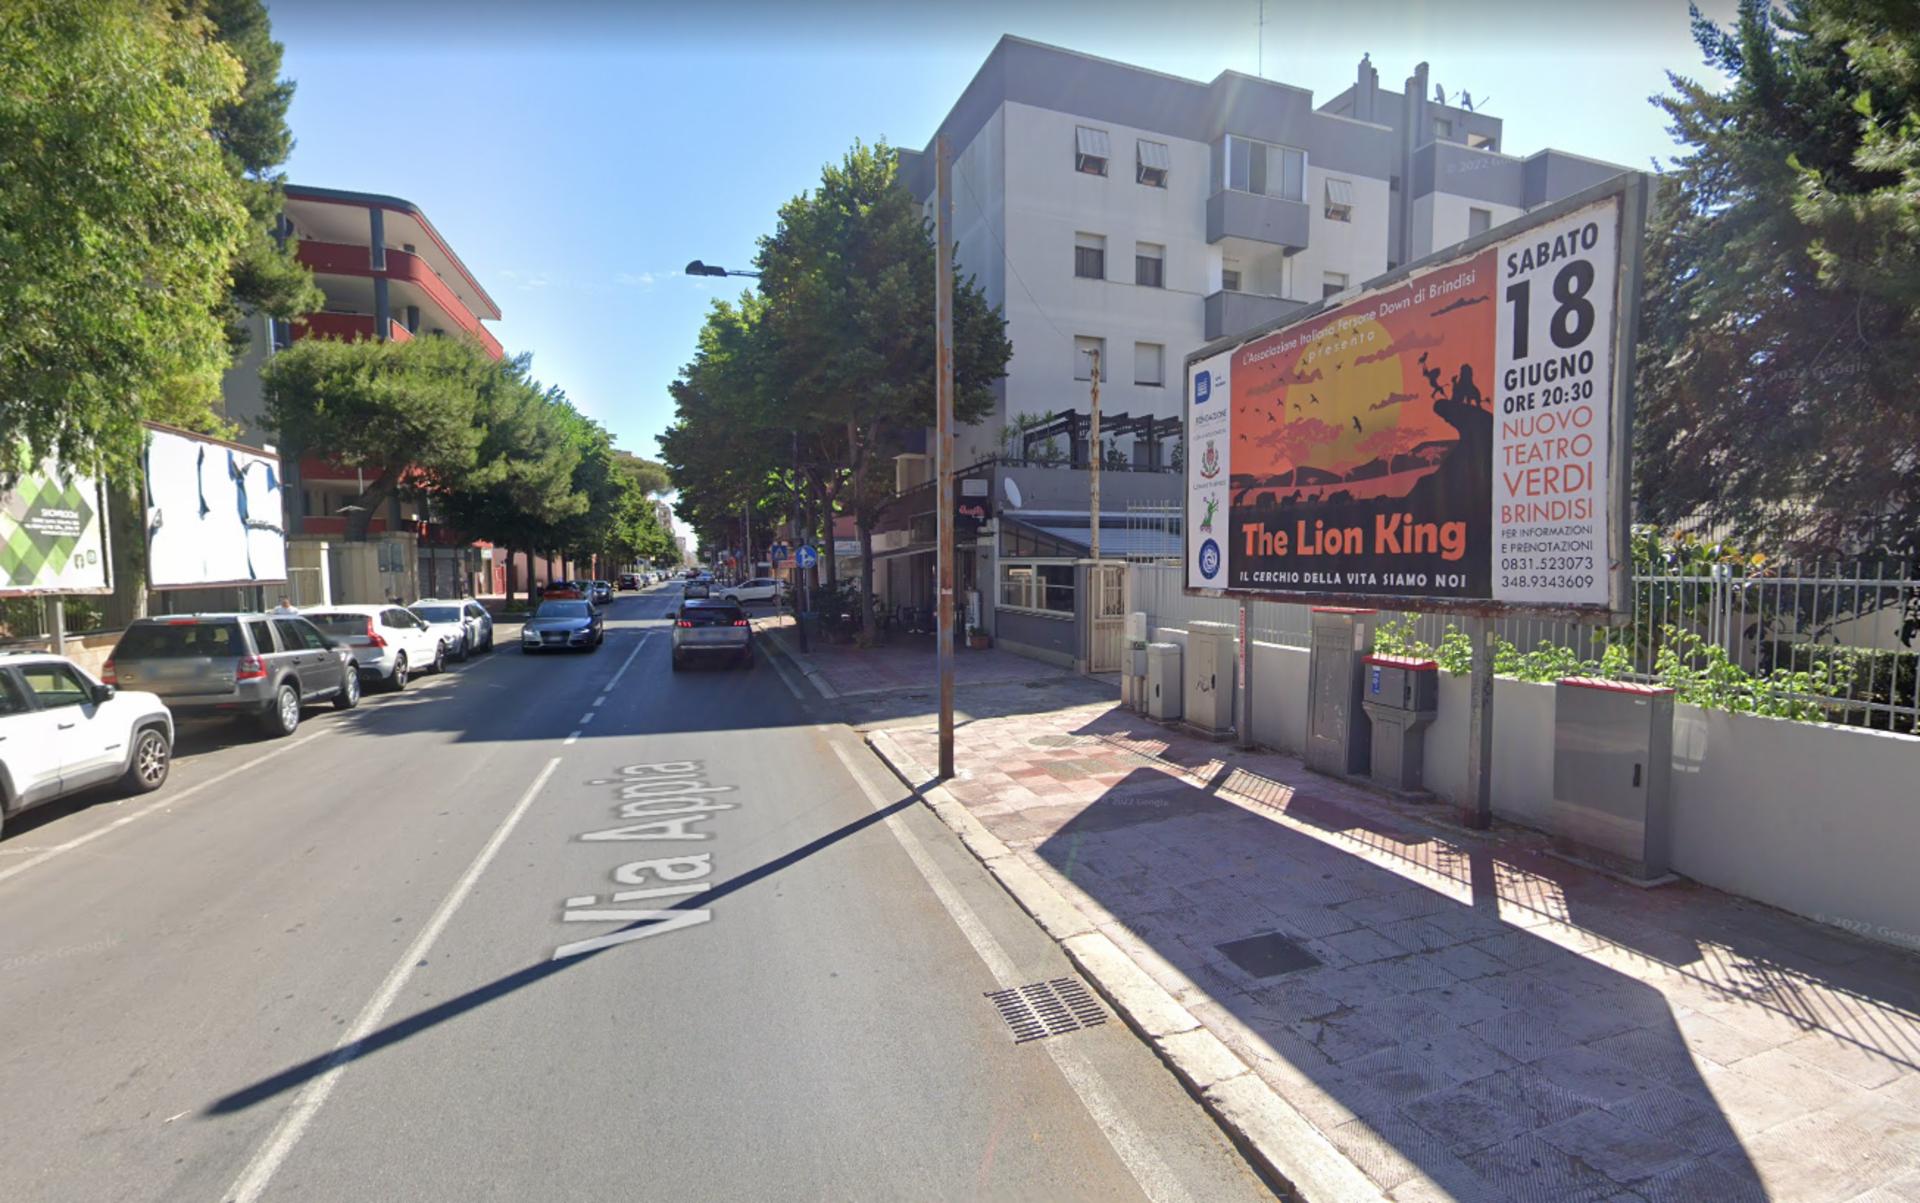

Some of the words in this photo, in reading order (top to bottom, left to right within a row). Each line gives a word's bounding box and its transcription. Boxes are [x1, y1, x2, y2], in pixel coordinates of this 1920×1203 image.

[1507, 222, 1599, 279] SABATO
[1379, 295, 1411, 317] Down
[1414, 287, 1426, 305] di
[1429, 270, 1477, 299] Brindisi
[1505, 259, 1596, 361] 18
[1504, 350, 1594, 392] GIUGNO
[1503, 392, 1535, 414] ORE
[1541, 379, 1593, 408] 20:30
[1503, 405, 1593, 440] NUOVO
[1503, 433, 1593, 466] TEATRO
[1502, 461, 1593, 497] VERDI
[1501, 498, 1593, 524] BRINDISI
[1242, 522, 1289, 557] The
[1296, 519, 1364, 556] Lion
[1374, 512, 1467, 561] King
[1501, 528, 1518, 539] PER
[1519, 525, 1593, 539] INFORMAZIONI
[1501, 543, 1507, 553] E
[1510, 540, 1593, 553] PRENOTAZIONI
[1239, 571, 1250, 582] IL
[1252, 571, 1300, 584] CERCHIO
[1303, 572, 1342, 585] DELLA
[1347, 573, 1377, 585] VITA
[1382, 573, 1428, 587] SIAMO
[1435, 574, 1467, 588] NOI
[1501, 556, 1594, 571] 0831.523073
[1501, 575, 1594, 589] 348.9343609
